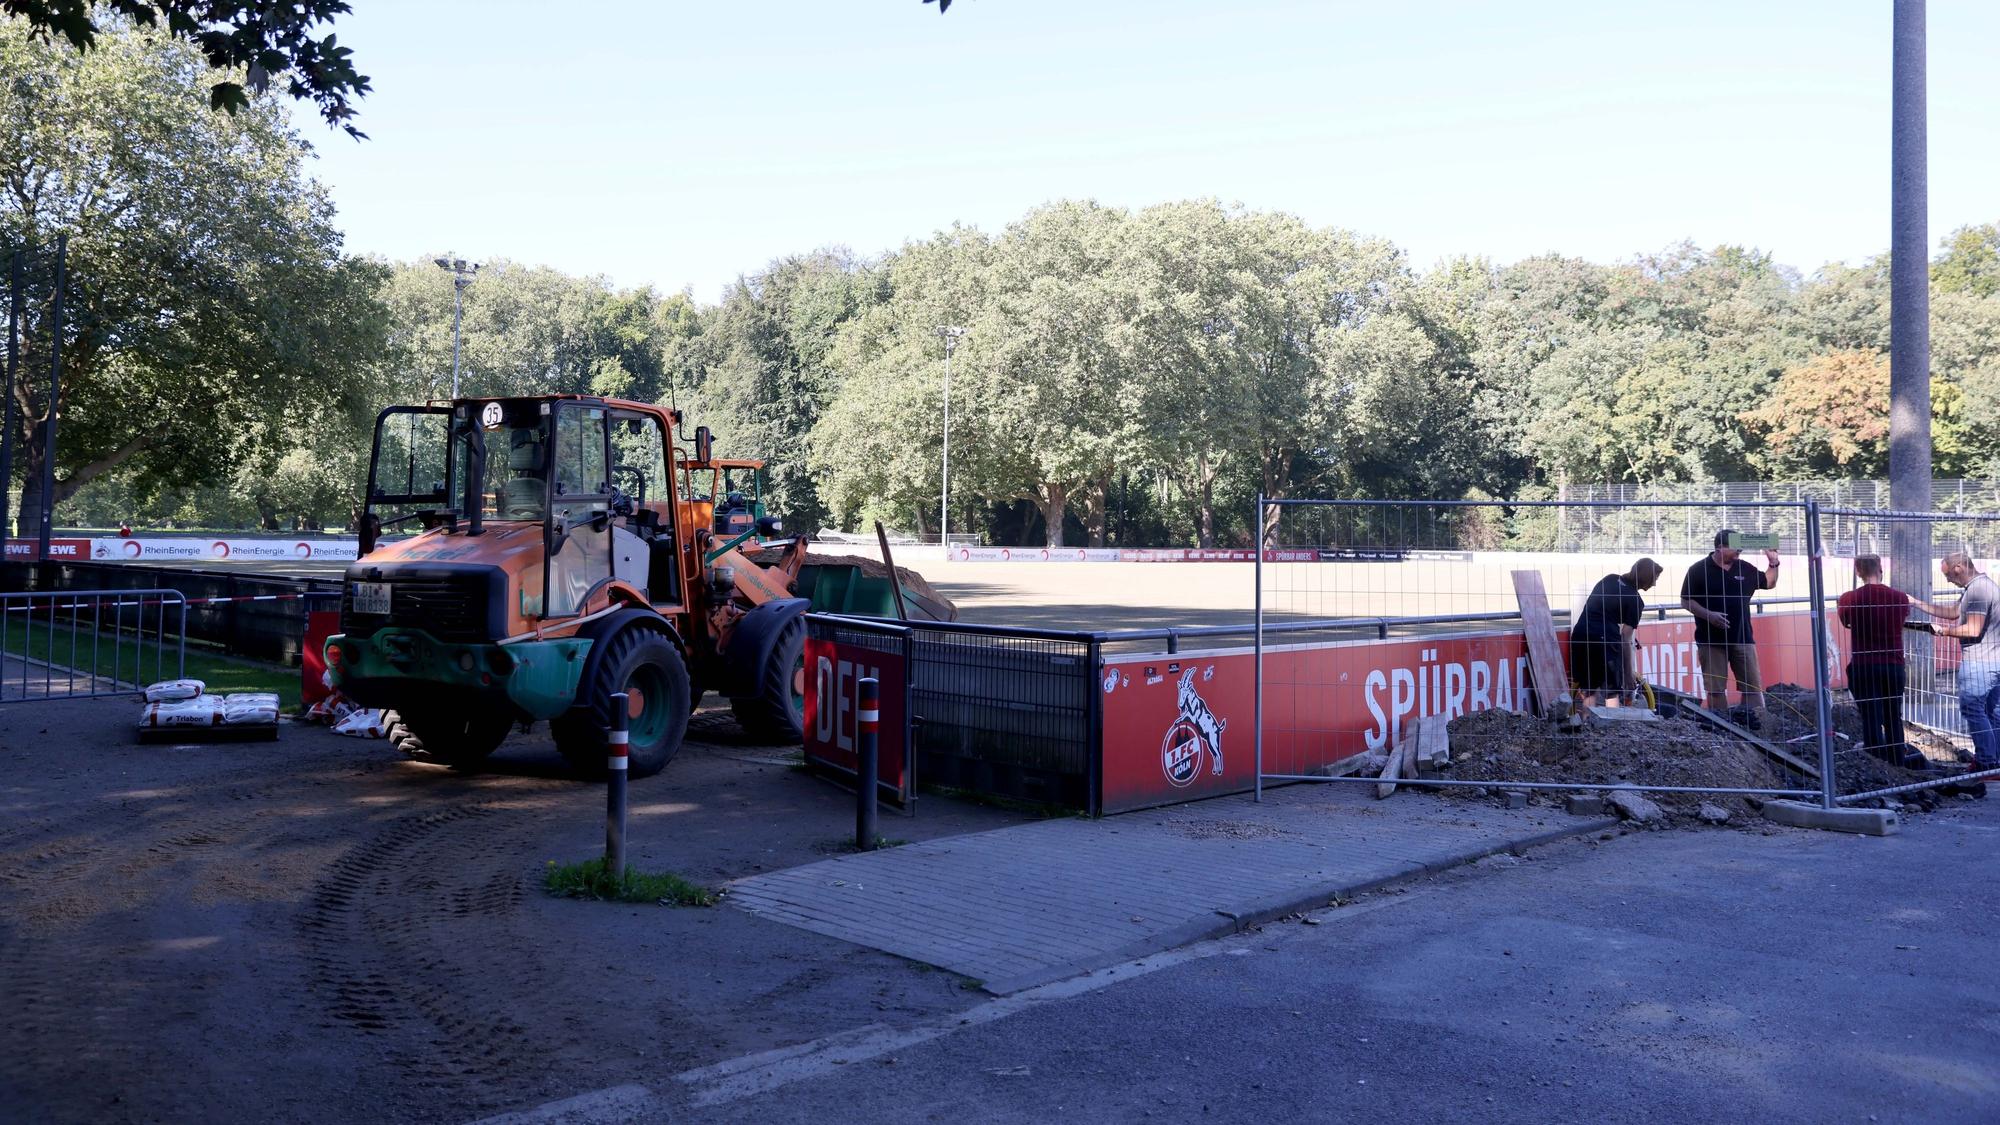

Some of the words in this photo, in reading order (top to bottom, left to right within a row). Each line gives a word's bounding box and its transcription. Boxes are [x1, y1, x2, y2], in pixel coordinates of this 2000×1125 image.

[487, 407, 499, 424] 35
[4, 545, 31, 554] EWE
[49, 545, 77, 555] EWE
[145, 547, 201, 556] RheinEnergie
[232, 547, 285, 556] RheinEnergie
[313, 548, 359, 557] RheinEnerg
[368, 599, 389, 612] 8138
[1174, 758, 1191, 777] KÖLN
